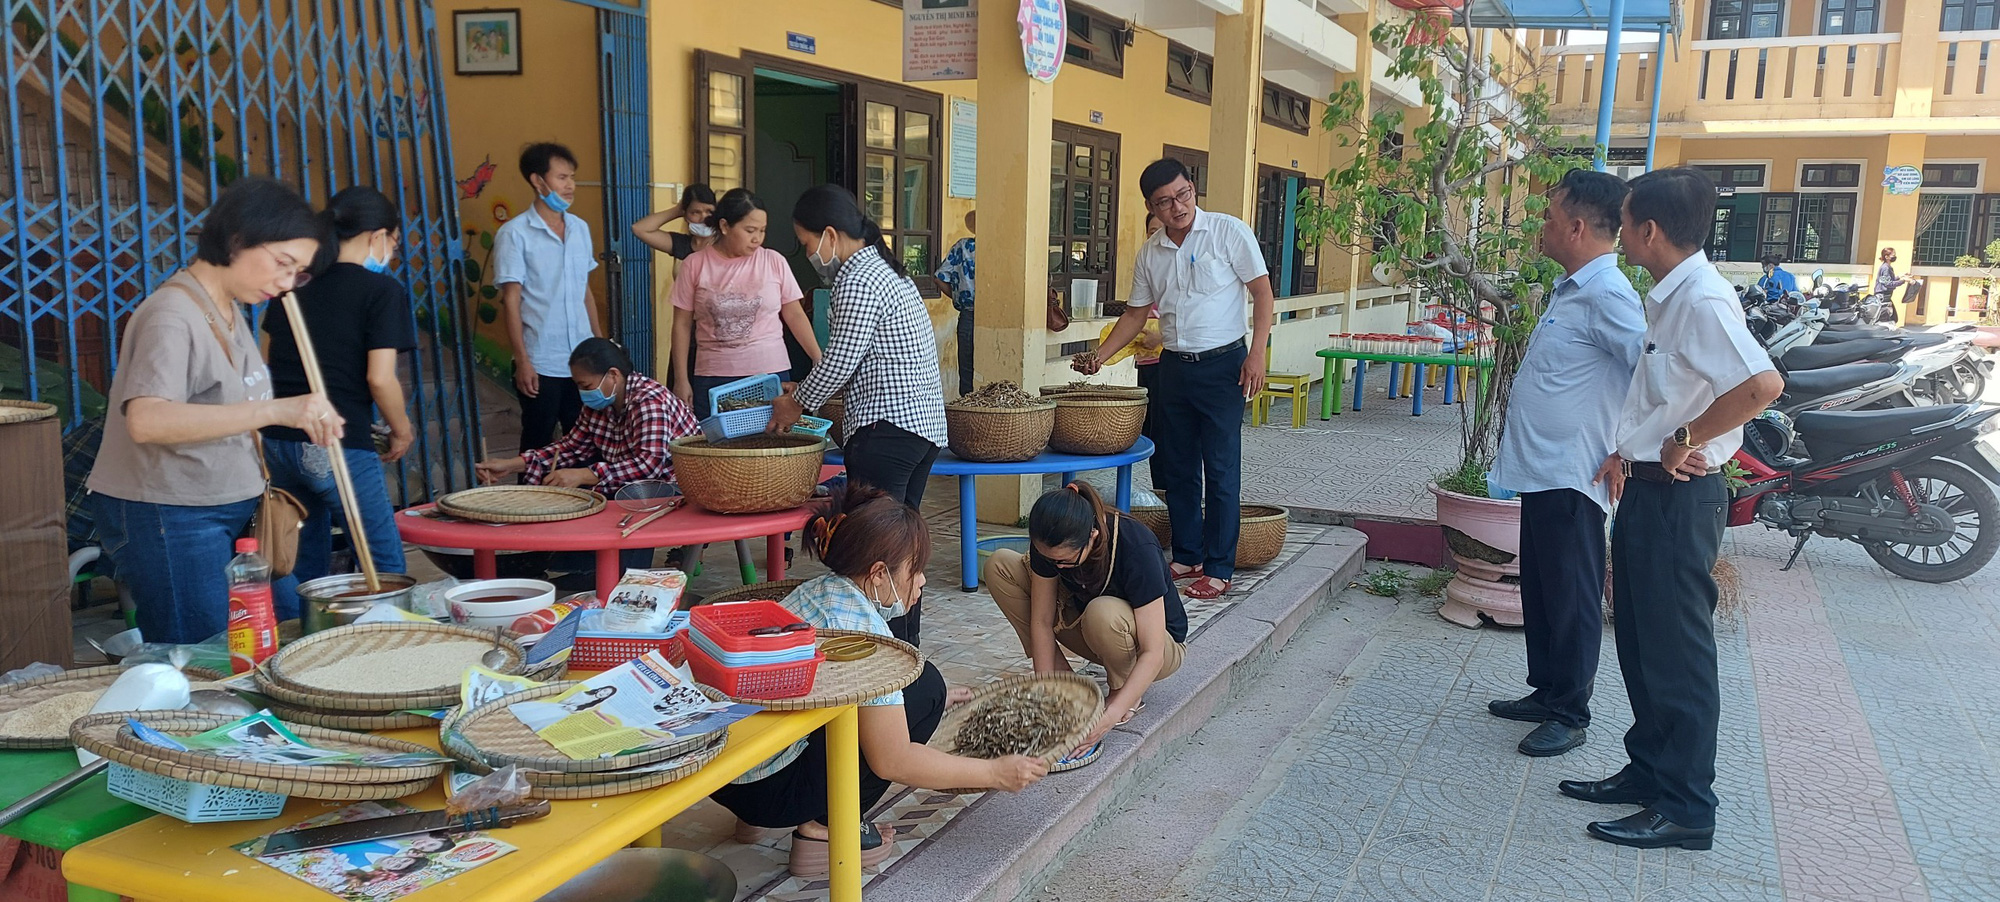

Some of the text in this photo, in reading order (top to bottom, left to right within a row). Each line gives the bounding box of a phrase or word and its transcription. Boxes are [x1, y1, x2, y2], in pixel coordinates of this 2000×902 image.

[909, 9, 935, 21] NGUYỄN
[936, 11, 947, 21] THỊ
[948, 11, 965, 19] MINH
